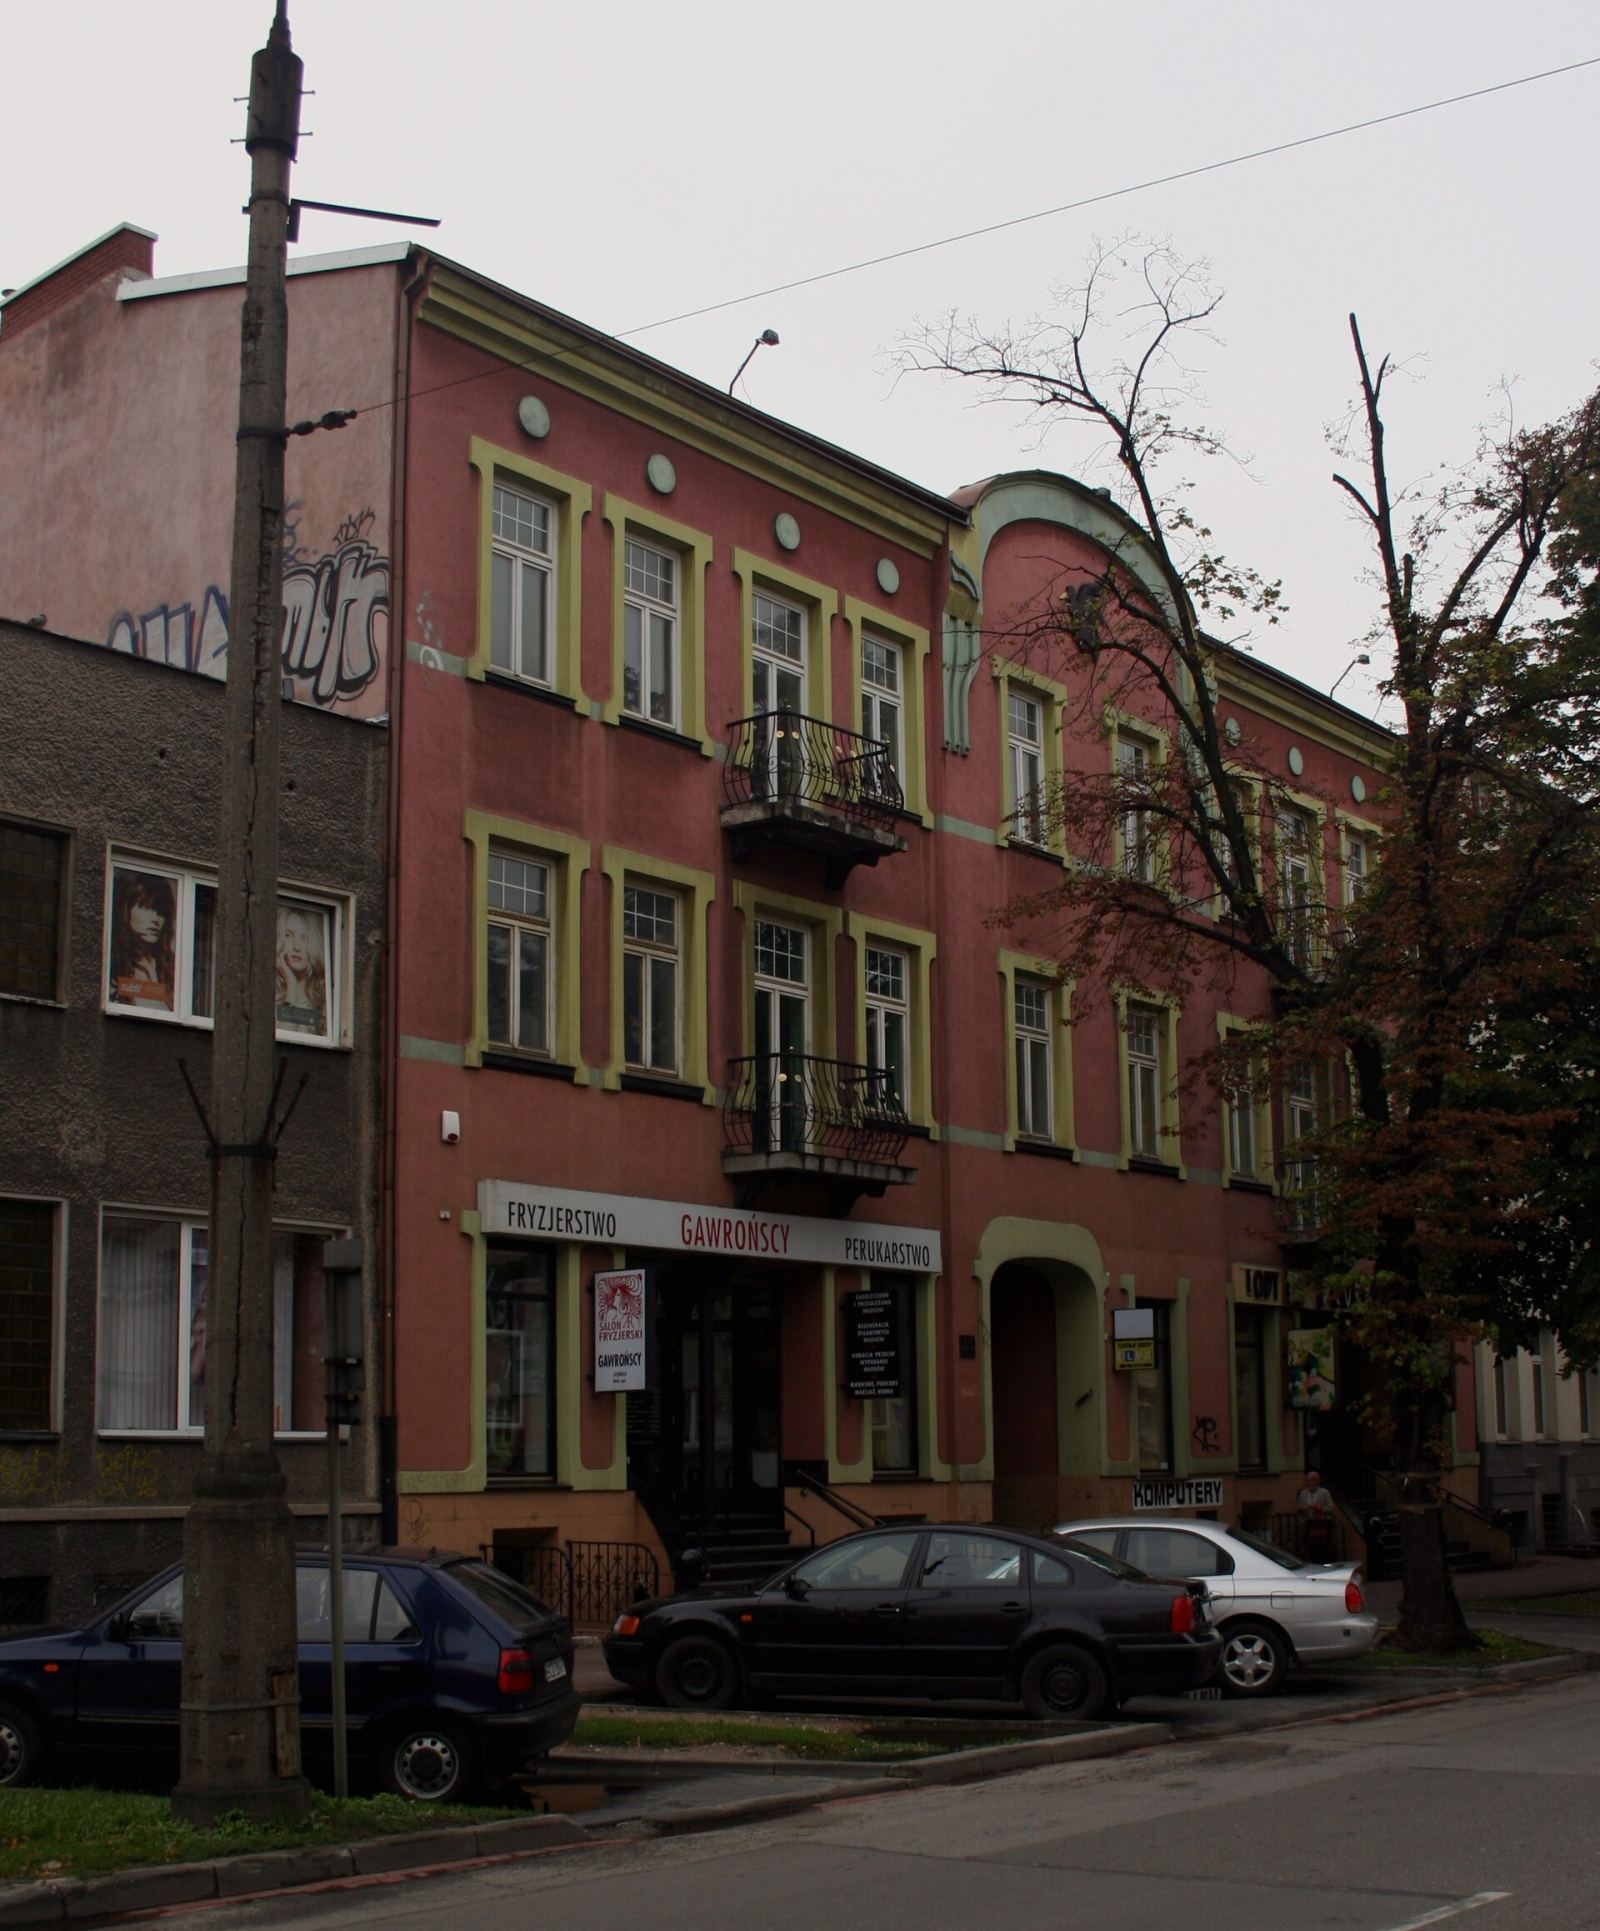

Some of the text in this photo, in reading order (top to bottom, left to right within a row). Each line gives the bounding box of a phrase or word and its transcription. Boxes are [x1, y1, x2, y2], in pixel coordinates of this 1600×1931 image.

[508, 1201, 930, 1266] FRYZJERSTWO GAWROŃSCY PERUKARSTWO
[599, 1329, 643, 1341] FRYZJERSKI
[600, 1321, 621, 1331] SALON
[598, 1350, 642, 1368] GAWROŃSCY
[1134, 1480, 1221, 1506] KOMPUTERY
